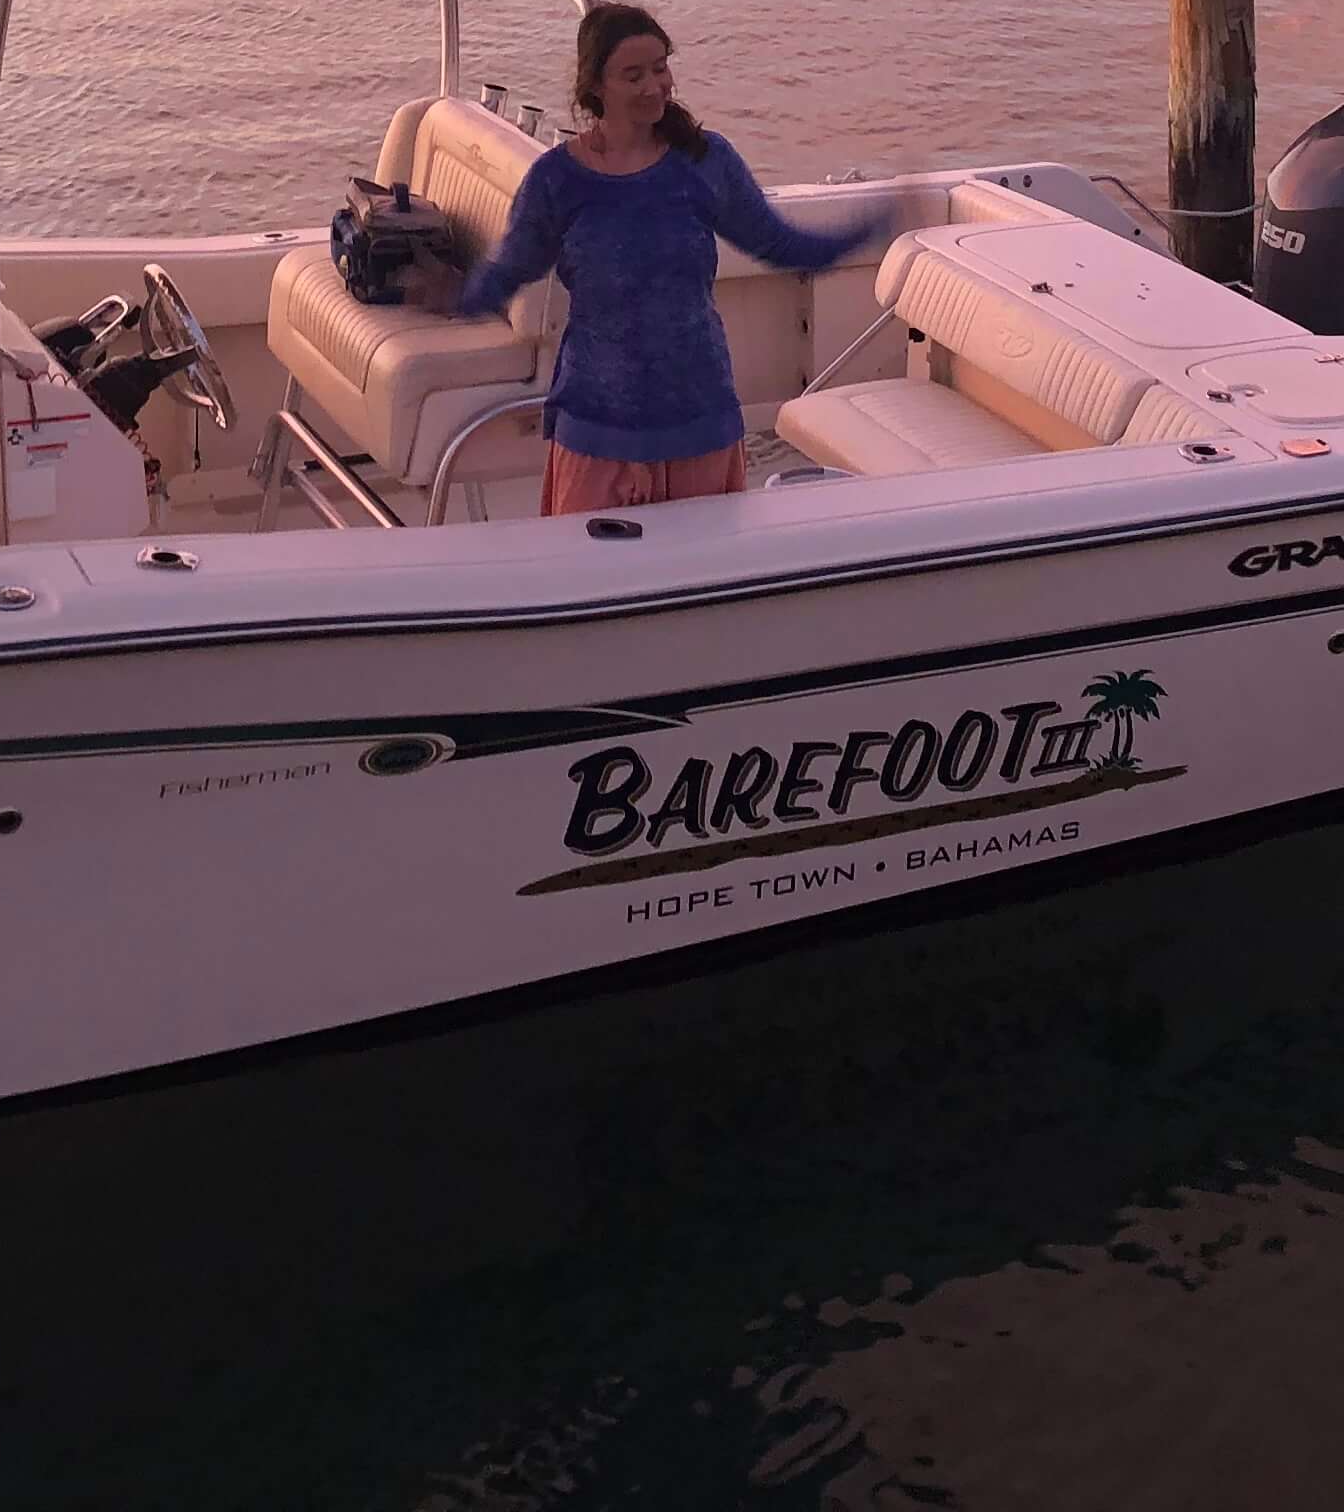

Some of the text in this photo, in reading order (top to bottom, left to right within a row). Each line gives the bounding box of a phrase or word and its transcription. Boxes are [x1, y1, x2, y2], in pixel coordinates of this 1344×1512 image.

[1261, 220, 1306, 255] 250
[158, 761, 332, 799] Fisherman
[562, 699, 1102, 856] BAREFOOT III
[625, 820, 1081, 924] HOPE TOWN BAHAMAS
